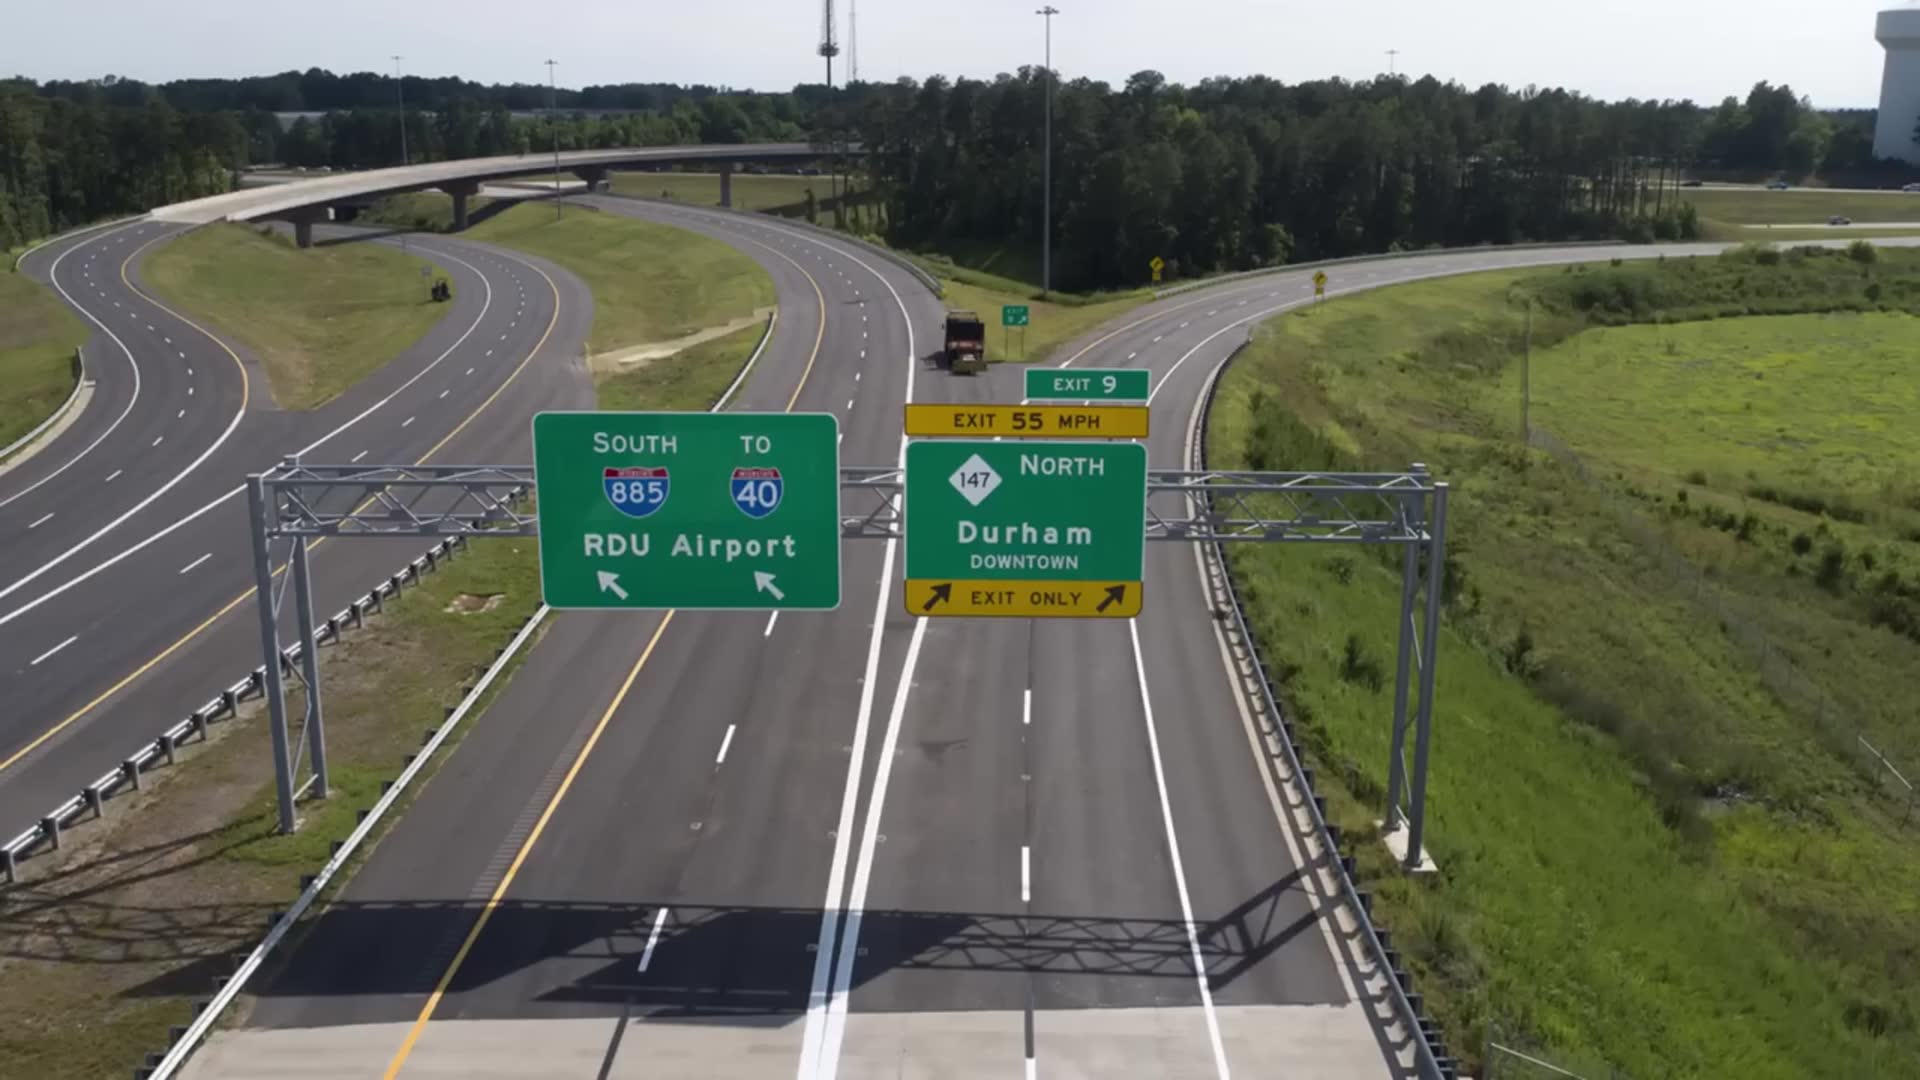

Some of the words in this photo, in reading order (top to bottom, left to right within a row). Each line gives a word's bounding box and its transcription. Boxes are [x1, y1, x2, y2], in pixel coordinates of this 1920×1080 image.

[1054, 378, 1090, 391] EXIT
[1102, 376, 1116, 393] 9
[954, 413, 996, 428] EXIT
[1012, 412, 1044, 430] 55
[1058, 415, 1100, 429] MPH
[593, 432, 678, 454] SOUTH
[740, 435, 771, 454] TO
[1020, 454, 1105, 476] NORTH
[960, 472, 991, 488] 147
[611, 481, 664, 503] 885
[736, 480, 778, 508] 40
[958, 521, 1092, 544] Durham
[584, 533, 650, 557] RDU
[671, 534, 796, 562] Airport
[970, 554, 1079, 570] DOWNTOWN
[971, 591, 1015, 605] EXIT
[1030, 591, 1082, 606] ONLY
